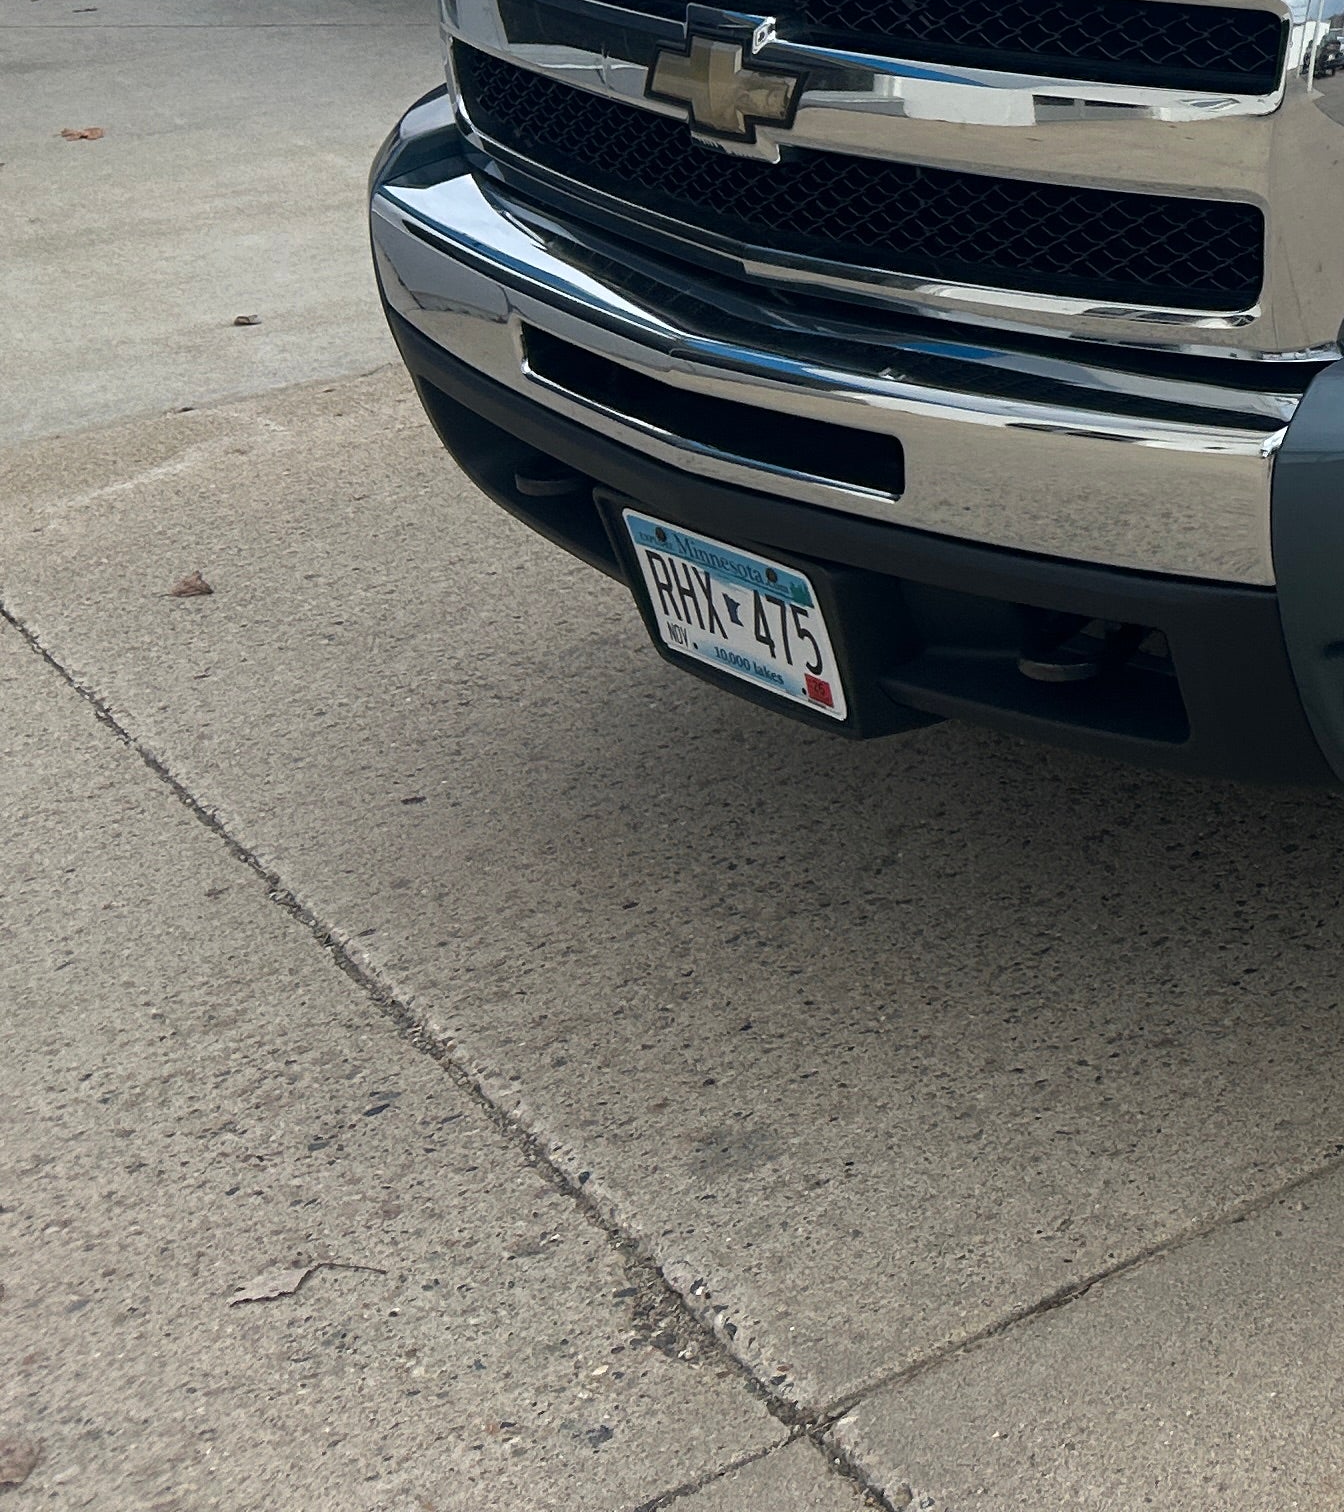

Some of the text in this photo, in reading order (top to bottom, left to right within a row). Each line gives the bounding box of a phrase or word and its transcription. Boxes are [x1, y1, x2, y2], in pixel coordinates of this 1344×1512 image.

[645, 549, 823, 676] RHX 475
[667, 621, 689, 648] NOV
[714, 646, 785, 685] 10,000 lakes
